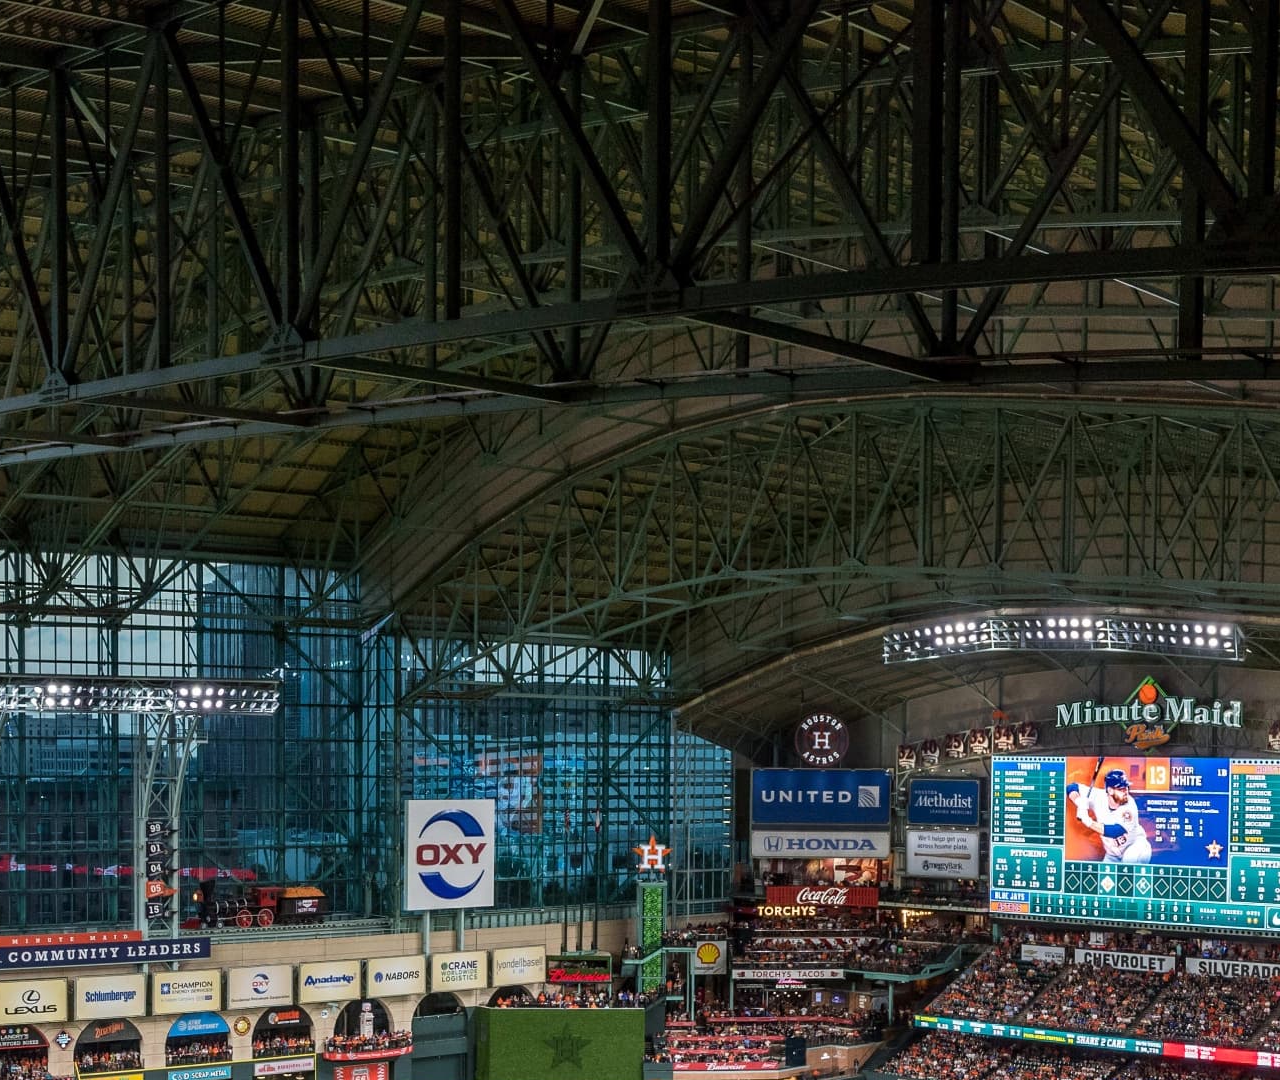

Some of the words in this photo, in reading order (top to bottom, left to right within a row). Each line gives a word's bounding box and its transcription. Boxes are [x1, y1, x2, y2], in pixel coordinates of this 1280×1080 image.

[1055, 698, 1161, 728] Minute
[1165, 696, 1242, 728] Maid
[801, 714, 843, 731] HOUSTON
[813, 731, 830, 750] H
[1125, 723, 1170, 749] Park
[802, 751, 841, 765] ASTROS
[1150, 766, 1166, 784] 13
[1172, 767, 1194, 775] TYLER
[1172, 776, 1202, 786] WHITE
[761, 790, 852, 803] UNITED
[914, 792, 973, 808] Methodist
[150, 824, 161, 832] 99
[150, 844, 161, 853] 01
[786, 838, 877, 850] HONDA
[416, 842, 487, 866] OXY
[639, 844, 666, 869] H
[150, 864, 161, 873] 04
[150, 884, 161, 893] 05
[149, 905, 159, 913] 15
[757, 905, 817, 917] TORCHYS
[11, 936, 75, 945] MINUTE
[89, 934, 130, 942] MAID
[8, 947, 120, 963] COMMUNITY
[127, 943, 201, 957] LEADERS
[448, 960, 478, 970] CRANE
[1083, 951, 1166, 971] CHEVROLET
[385, 970, 420, 981] NABORS
[441, 974, 478, 982] LOGISTICS
[549, 968, 610, 983] Budweiser
[752, 970, 792, 978] TORCHYS
[798, 970, 825, 978] TACOS
[171, 981, 213, 990] CHAMPION
[304, 973, 355, 988] Anadarko
[85, 990, 137, 1003] Schlumberger
[4, 1004, 58, 1015] LEXUS
[1076, 1035, 1100, 1046] SHARE
[1107, 1038, 1127, 1049] CARE
[705, 1062, 747, 1070] Budweiser
[191, 1071, 209, 1079] SCRAP
